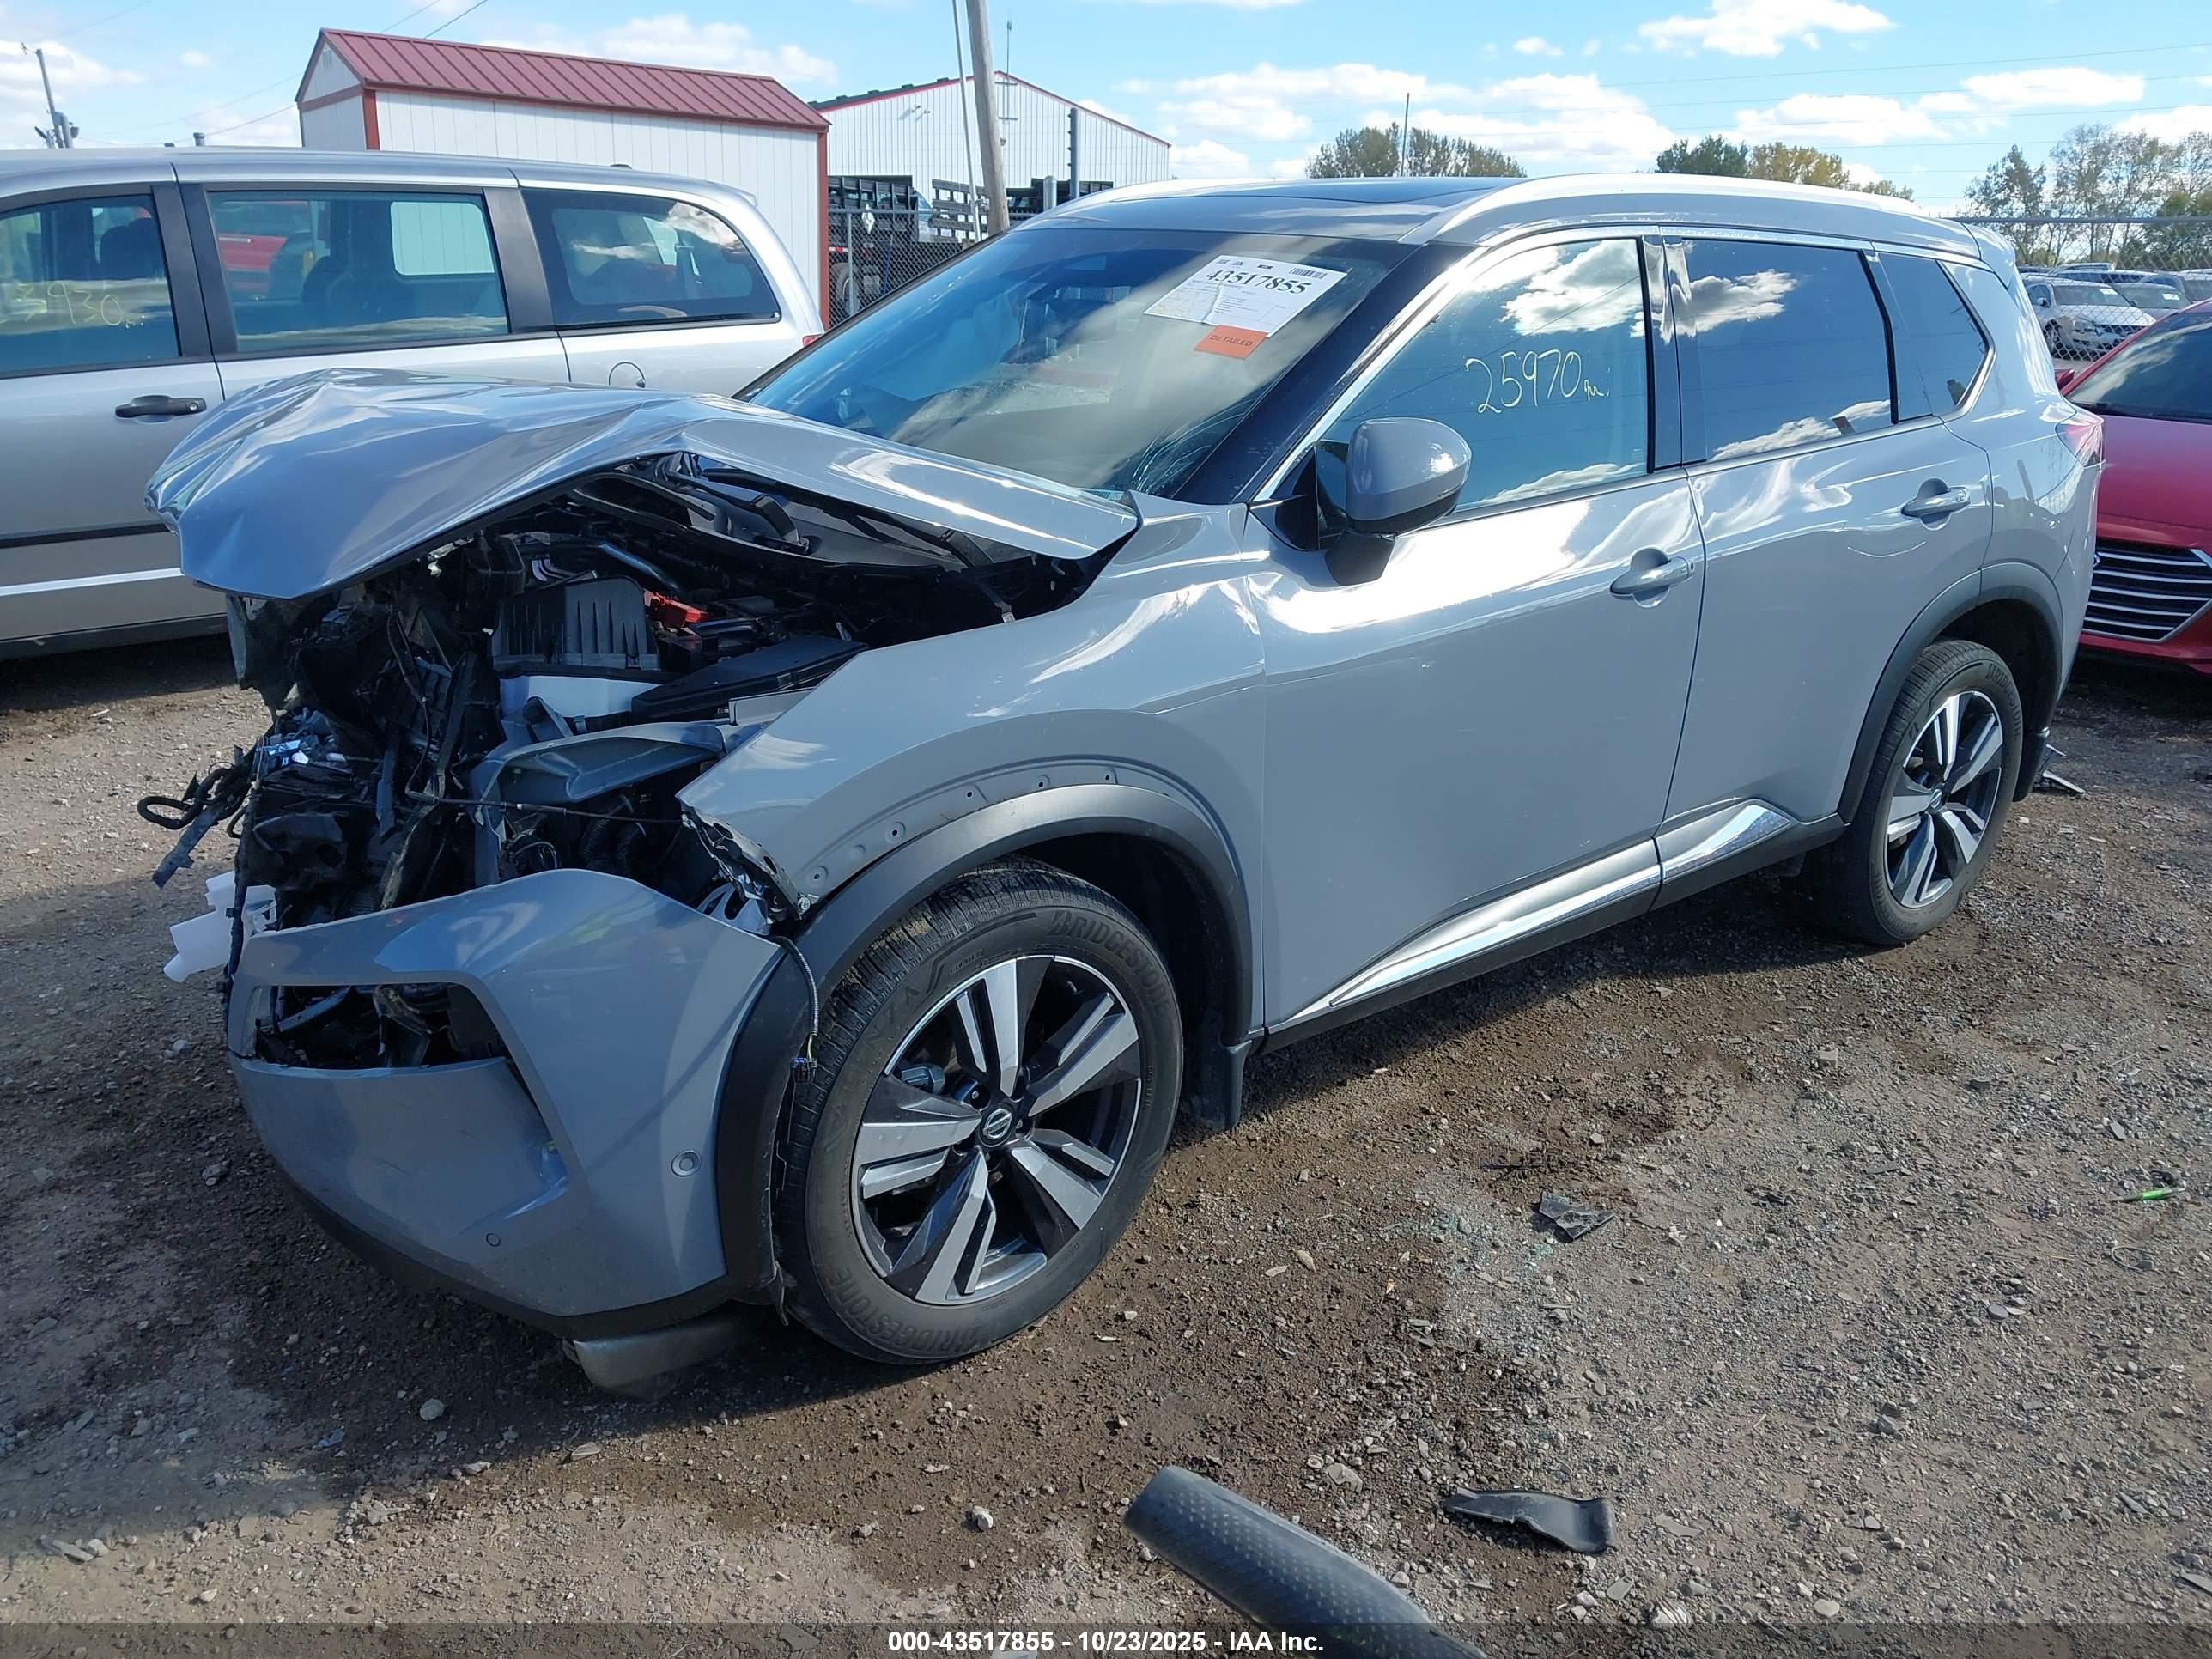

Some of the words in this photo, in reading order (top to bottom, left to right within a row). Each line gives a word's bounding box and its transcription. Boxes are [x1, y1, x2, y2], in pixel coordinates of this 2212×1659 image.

[1206, 269, 1312, 295] 43517855
[1209, 335, 1253, 347] DETAILED
[1047, 909, 1170, 1018] BRIDGESTONE
